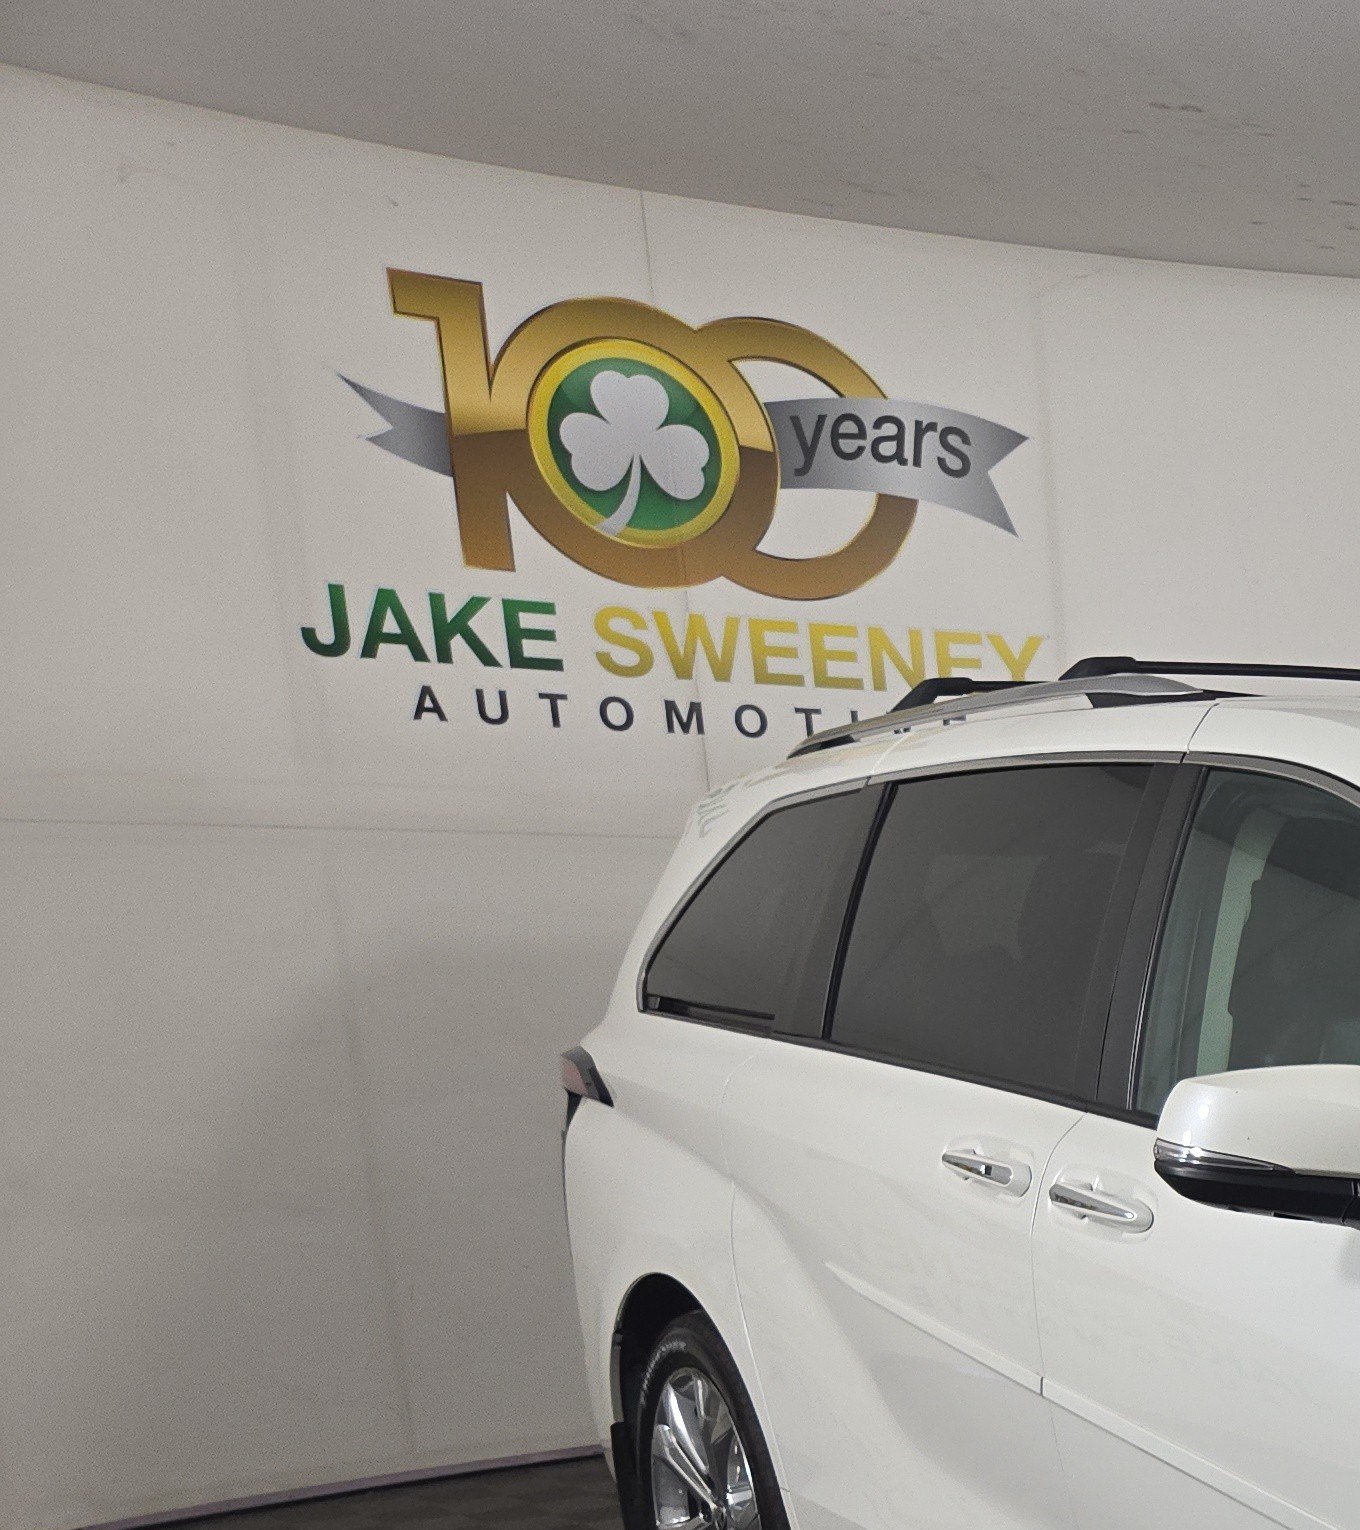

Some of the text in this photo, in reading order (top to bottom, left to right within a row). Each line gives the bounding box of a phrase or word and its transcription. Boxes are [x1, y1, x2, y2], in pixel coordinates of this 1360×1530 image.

[386, 267, 973, 600] 100 years
[300, 582, 1045, 692] JAKE SWEENEY
[413, 685, 966, 738] AUTOMOT
